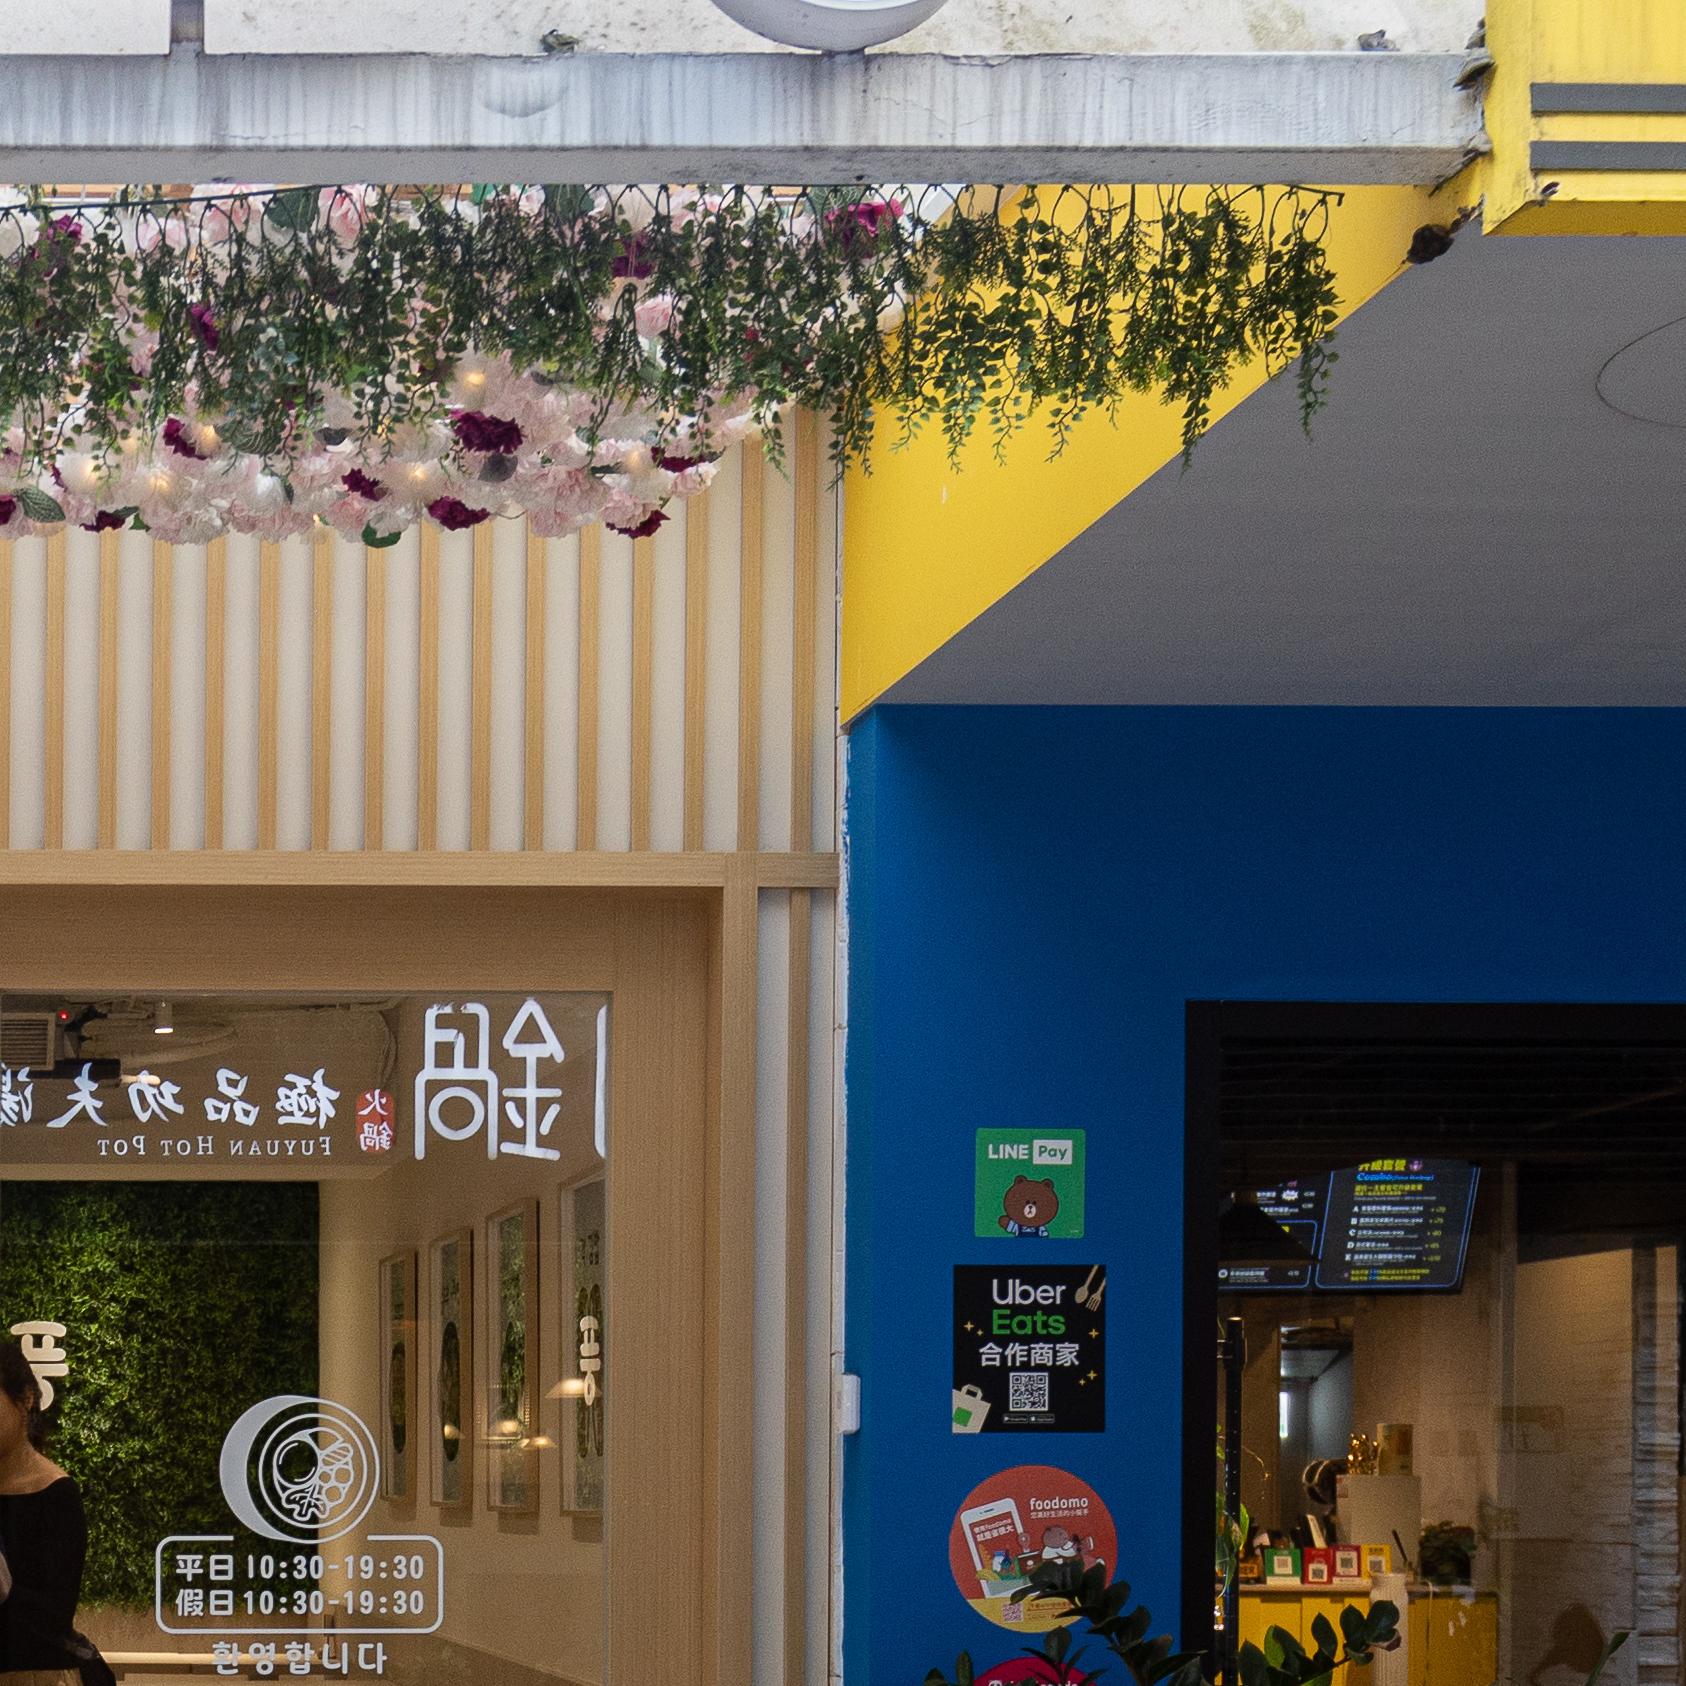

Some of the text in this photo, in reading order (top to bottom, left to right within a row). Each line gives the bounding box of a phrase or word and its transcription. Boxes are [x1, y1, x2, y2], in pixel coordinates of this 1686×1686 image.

[988, 1143, 1067, 1160] LINE Pay
[992, 1279, 1066, 1305] Uber
[992, 1309, 1066, 1335] Eats
[979, 1341, 1080, 1367] 合作商家
[1030, 1497, 1089, 1510] foodomo
[175, 1554, 424, 1581] 平日 10:30-19:30
[175, 1589, 424, 1616] 假日 10:30-19:30
[212, 1641, 387, 1675] 환영합니다
